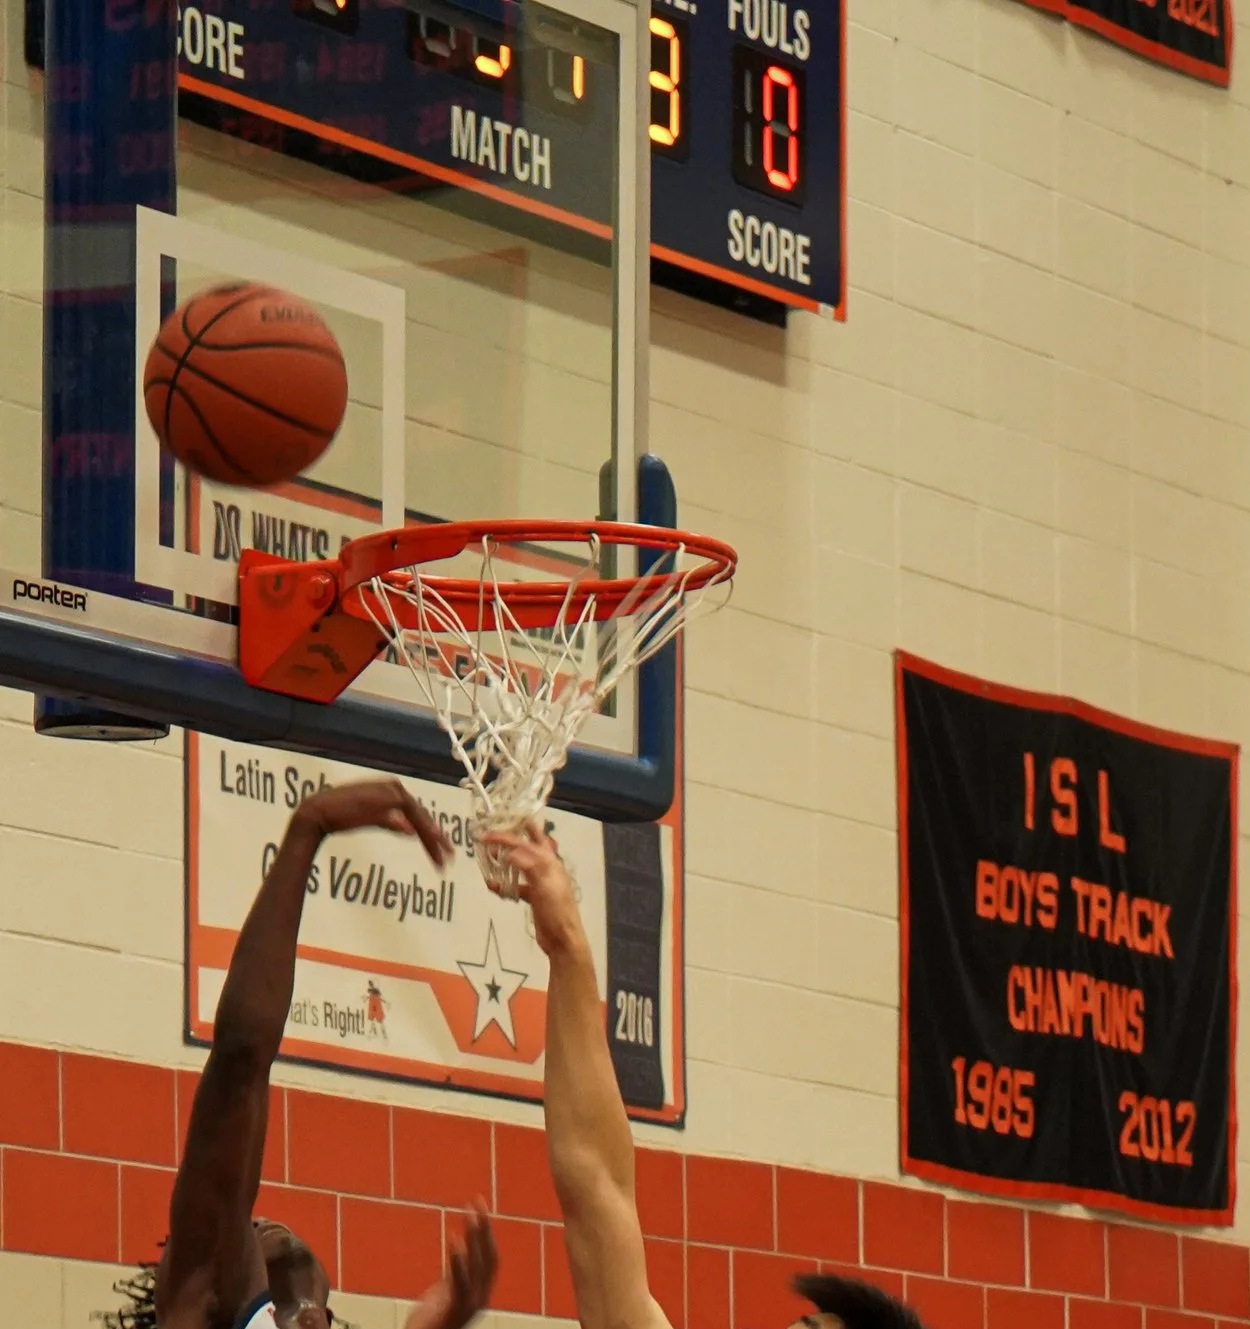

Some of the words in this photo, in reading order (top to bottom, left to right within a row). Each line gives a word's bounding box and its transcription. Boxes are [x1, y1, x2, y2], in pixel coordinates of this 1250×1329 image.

[177, 6, 245, 80] ORE
[728, 0, 811, 61] FOULS
[451, 105, 551, 189] MATCH
[728, 209, 811, 286] SCORE
[213, 500, 241, 563] DO
[252, 510, 329, 563] WHAT'S
[220, 750, 275, 804] Latin
[330, 856, 455, 922] Volleyball
[975, 860, 1059, 930] BOYS
[1071, 876, 1175, 959] TRACK
[323, 1001, 366, 1038] Right!
[615, 989, 653, 1048] 2016
[1007, 964, 1144, 1056] CHAMPIONS
[952, 1056, 1036, 1139] 1985
[1119, 1091, 1196, 1166] 2012
